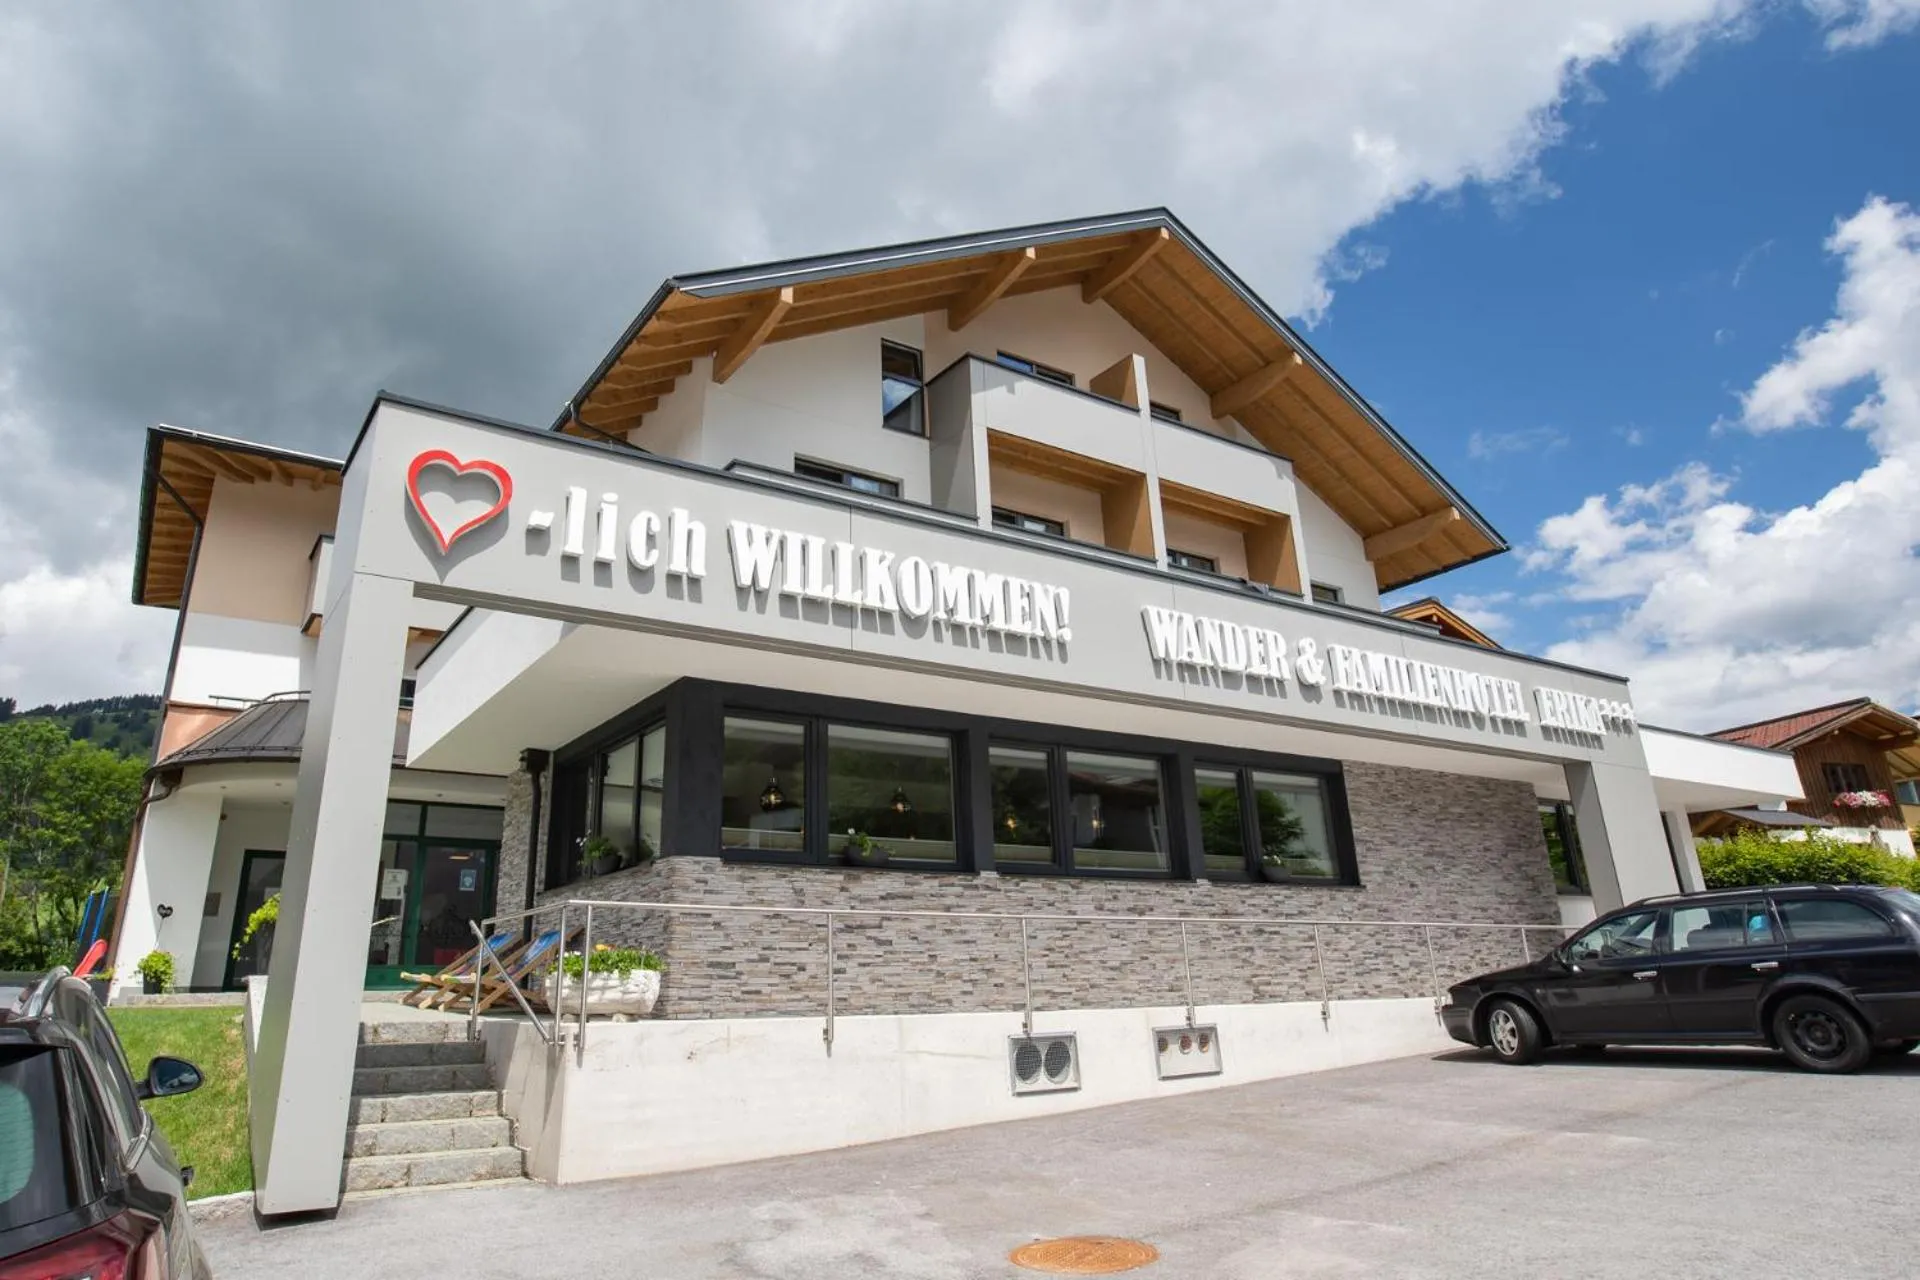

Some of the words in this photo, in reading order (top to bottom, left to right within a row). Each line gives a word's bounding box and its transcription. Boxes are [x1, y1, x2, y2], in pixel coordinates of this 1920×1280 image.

[728, 520, 1072, 644] WILLKOMMEN!
[1141, 604, 1290, 681] WANDER
[1297, 637, 1327, 687] &
[1328, 643, 1531, 723] FAMILIENHOTEL
